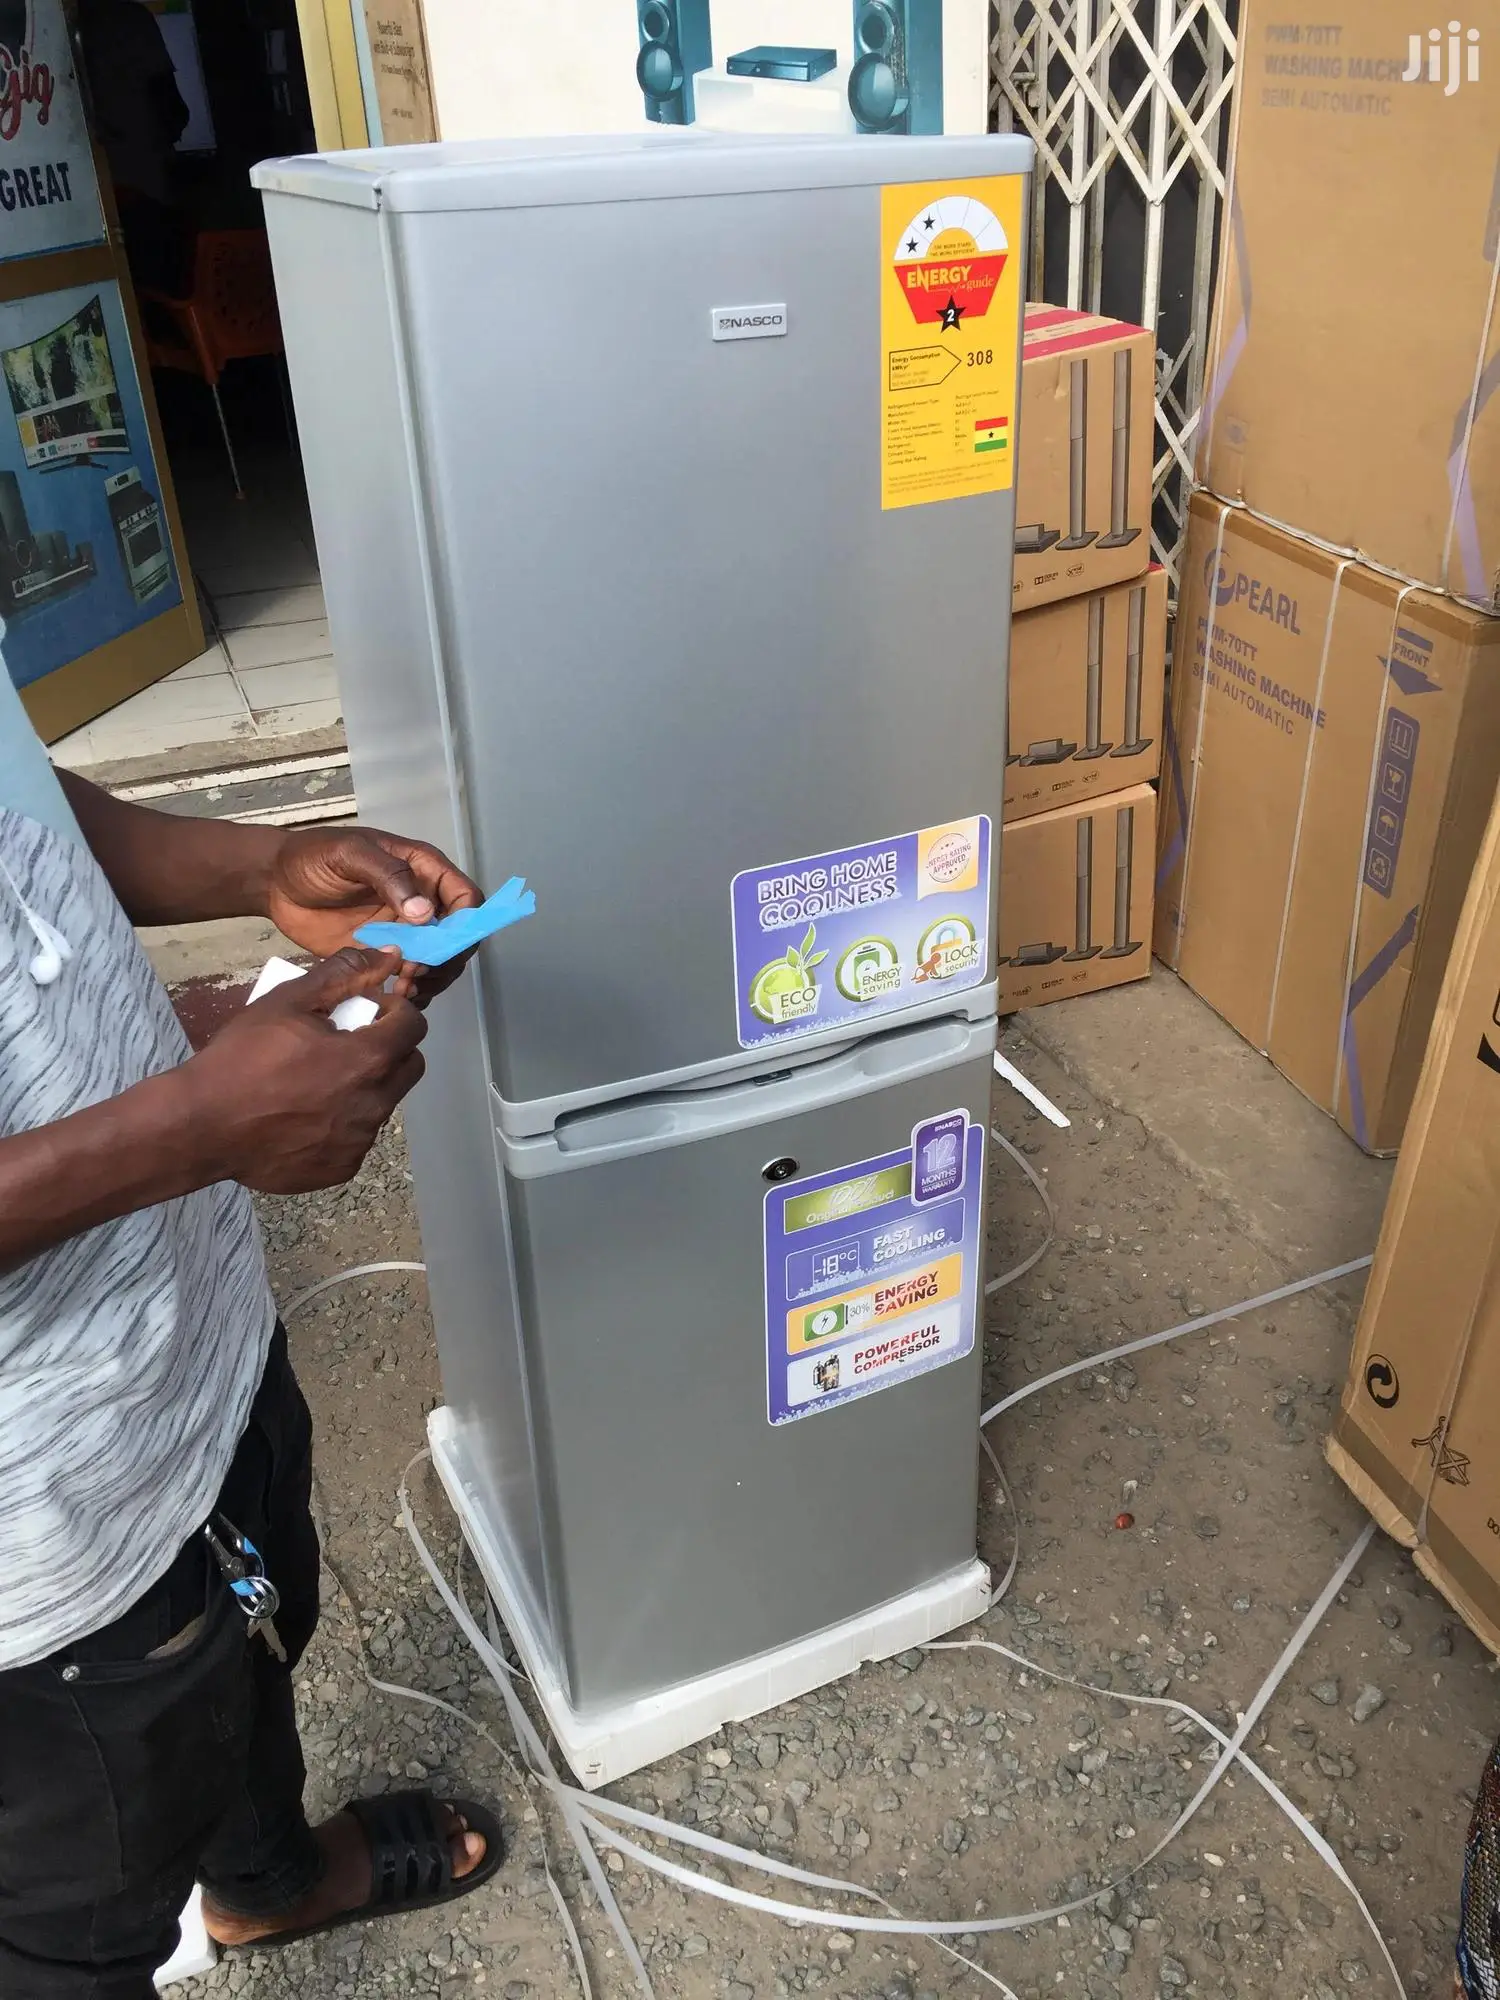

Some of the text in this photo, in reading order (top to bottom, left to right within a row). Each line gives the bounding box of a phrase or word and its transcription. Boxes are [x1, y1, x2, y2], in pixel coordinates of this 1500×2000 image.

[1264, 55, 1342, 79] WASHING
[1261, 87, 1393, 115] SEMI AUTOMATIC
[0, 162, 72, 211] GREAT
[906, 264, 995, 292] ENERGY guide
[731, 315, 783, 328] NASCO
[946, 308, 956, 322] 2
[966, 349, 994, 367] 308
[1234, 572, 1303, 636] PEARL
[1392, 642, 1430, 668] FRONT
[1196, 637, 1327, 729] WASHING MACHINE
[1222, 681, 1295, 735] AUTOMATIC
[933, 853, 966, 873] APPROVED
[758, 851, 898, 903] BRING HOME
[760, 876, 898, 928] COOLNESS
[943, 942, 979, 964] LOCK
[944, 956, 979, 975] security
[862, 966, 902, 986] ENERGY
[863, 978, 901, 995] saving
[780, 987, 817, 1008] ECO
[781, 1003, 816, 1020] friendly
[922, 1133, 957, 1172] 12
[921, 1167, 957, 1187] MONTHS
[922, 1177, 956, 1194] WARRANTY
[872, 1227, 946, 1263] COOLING
[873, 1225, 915, 1250] FAST
[874, 1270, 940, 1302] ENERGY
[849, 1301, 871, 1318] 30%
[874, 1283, 940, 1316] SAVING
[853, 1323, 941, 1364] POWERFUL
[853, 1336, 941, 1375] COMPRESSOR
